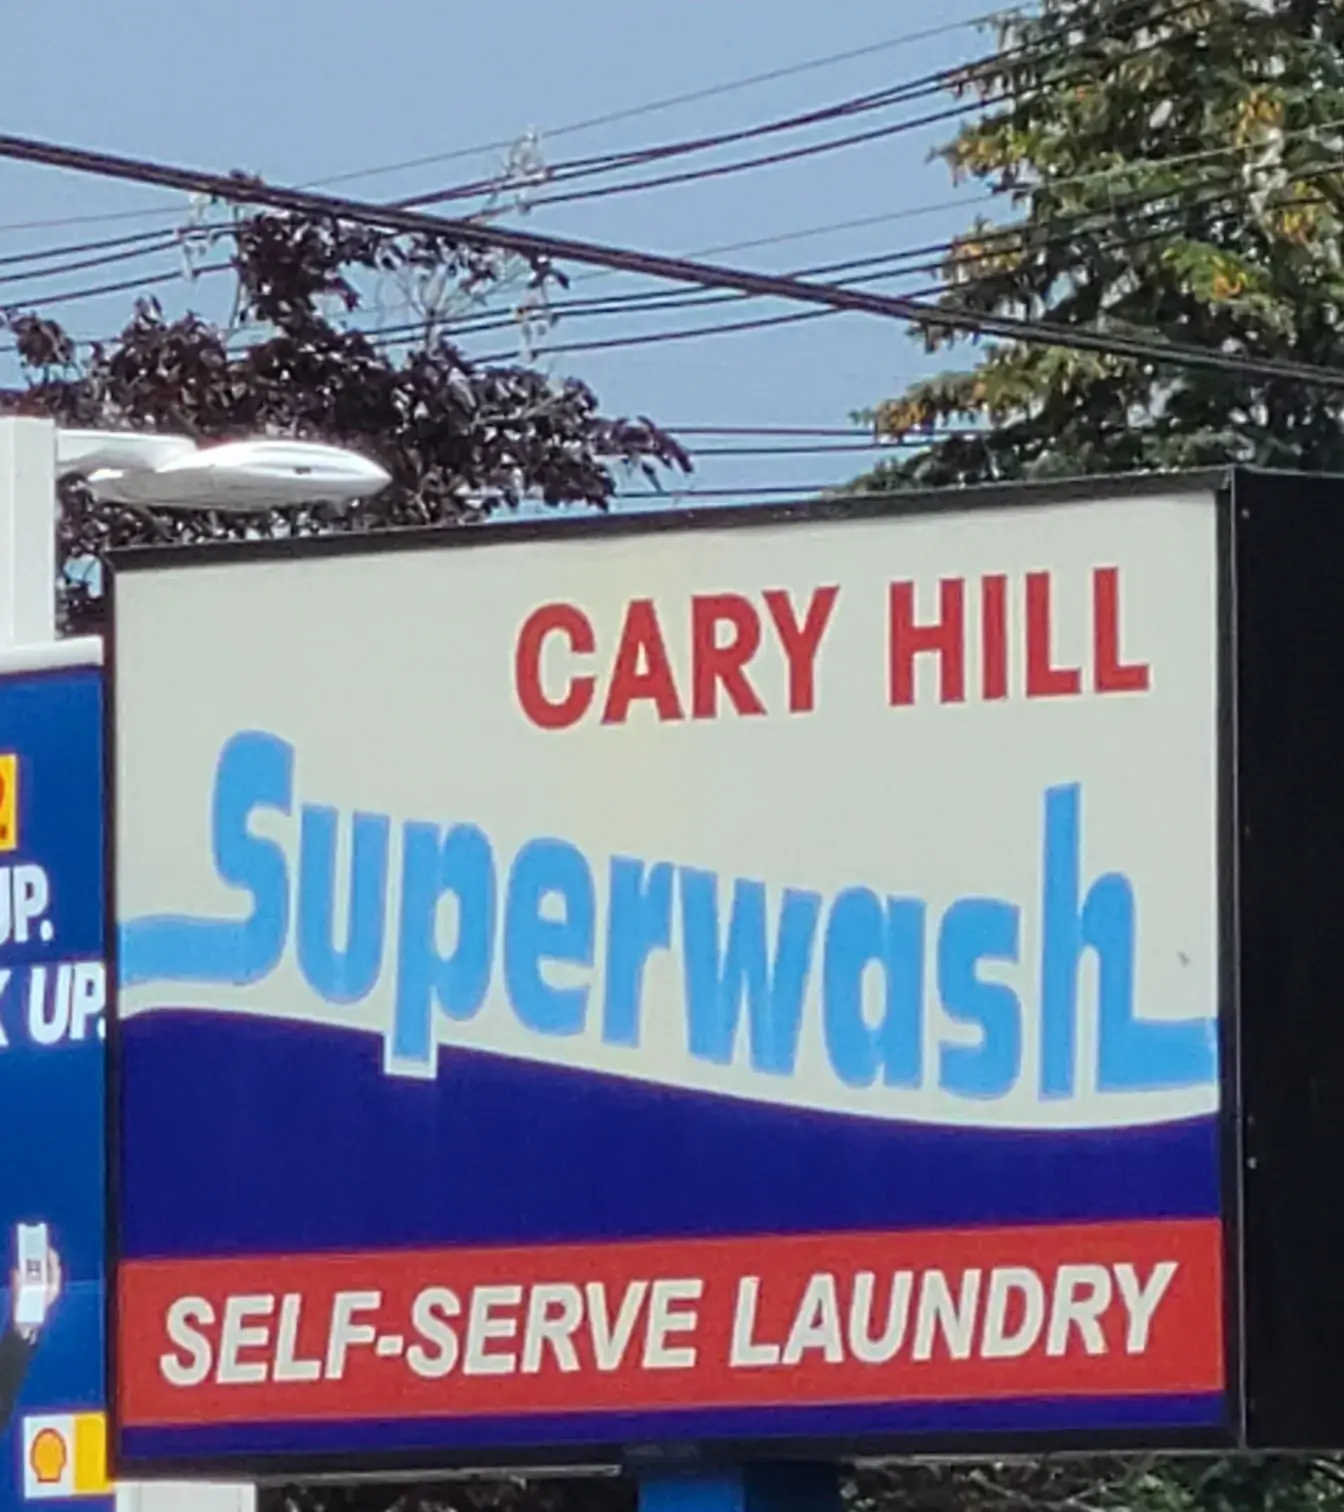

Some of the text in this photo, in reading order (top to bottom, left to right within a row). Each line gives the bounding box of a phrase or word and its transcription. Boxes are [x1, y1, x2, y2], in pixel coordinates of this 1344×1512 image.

[514, 566, 1150, 731] CARY HILL
[119, 729, 1218, 1102] Superwash
[29, 961, 106, 1045] UP.
[159, 1259, 1178, 1386] SELF-SERVE LAUNDRY
